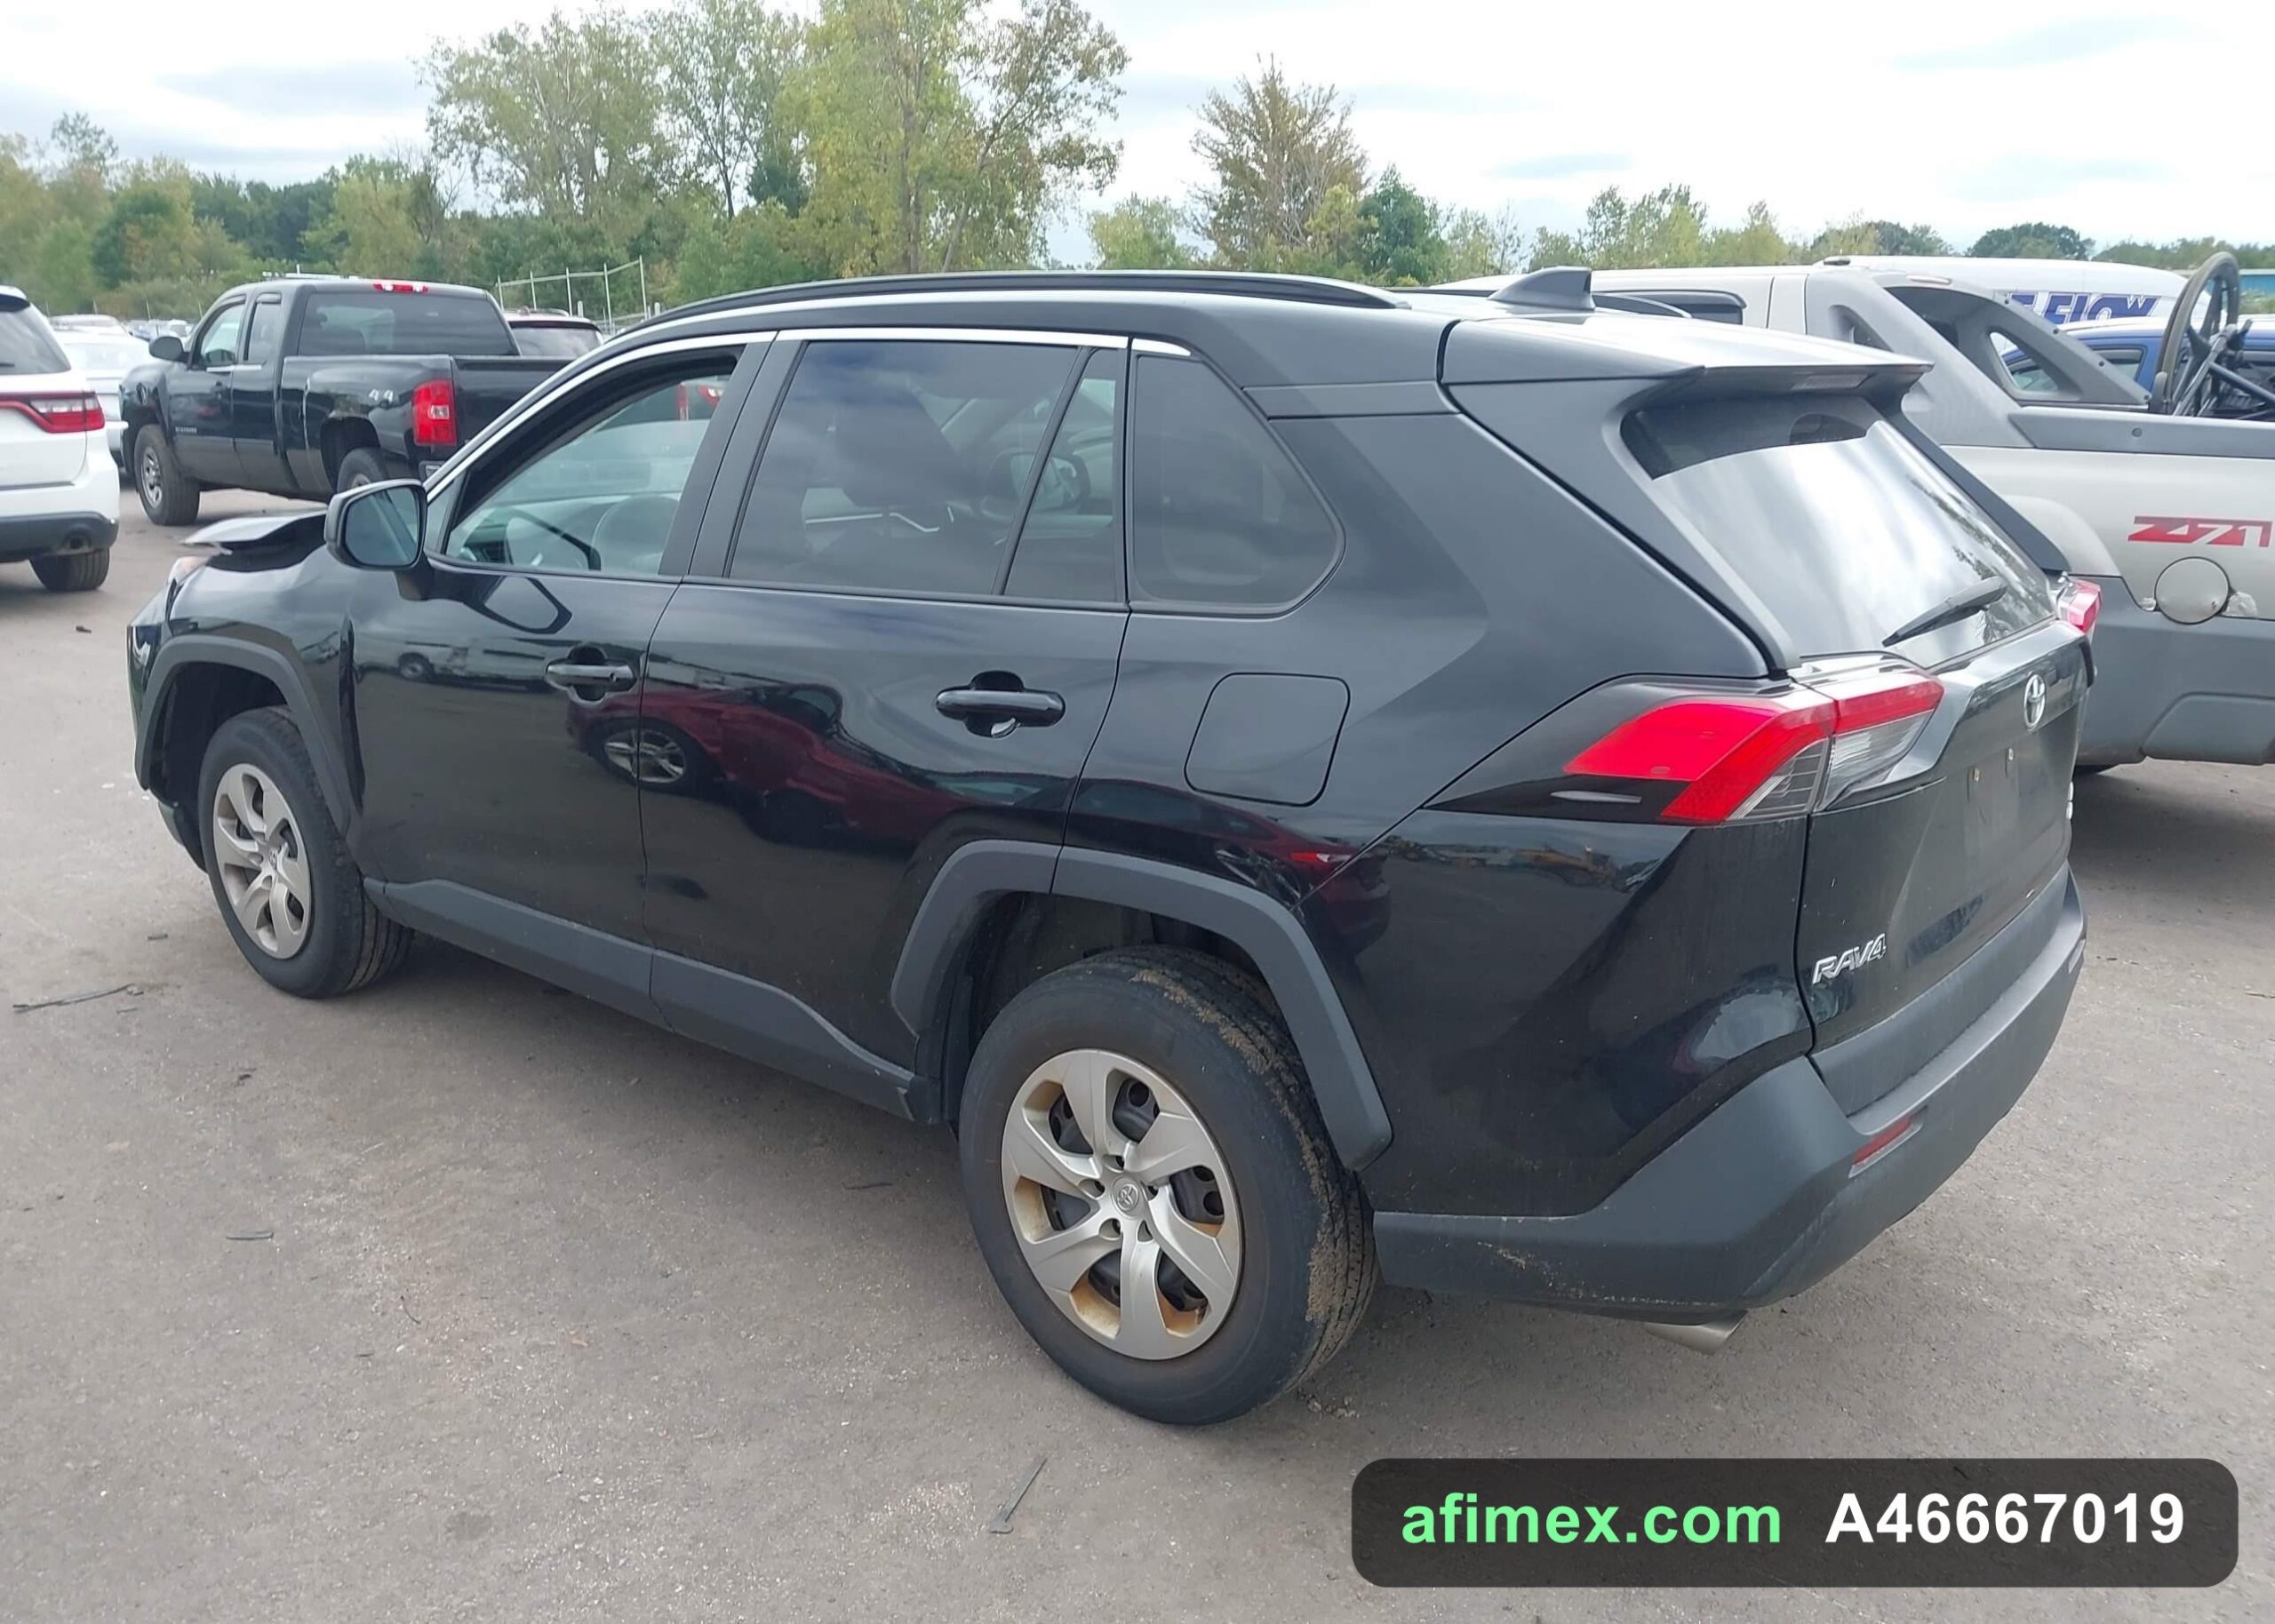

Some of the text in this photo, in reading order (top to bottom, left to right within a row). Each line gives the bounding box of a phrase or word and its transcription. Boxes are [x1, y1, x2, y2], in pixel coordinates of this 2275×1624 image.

[368, 389, 394, 402] 44
[2127, 515, 2272, 548] Z71
[1812, 933, 1887, 984] RAV4
